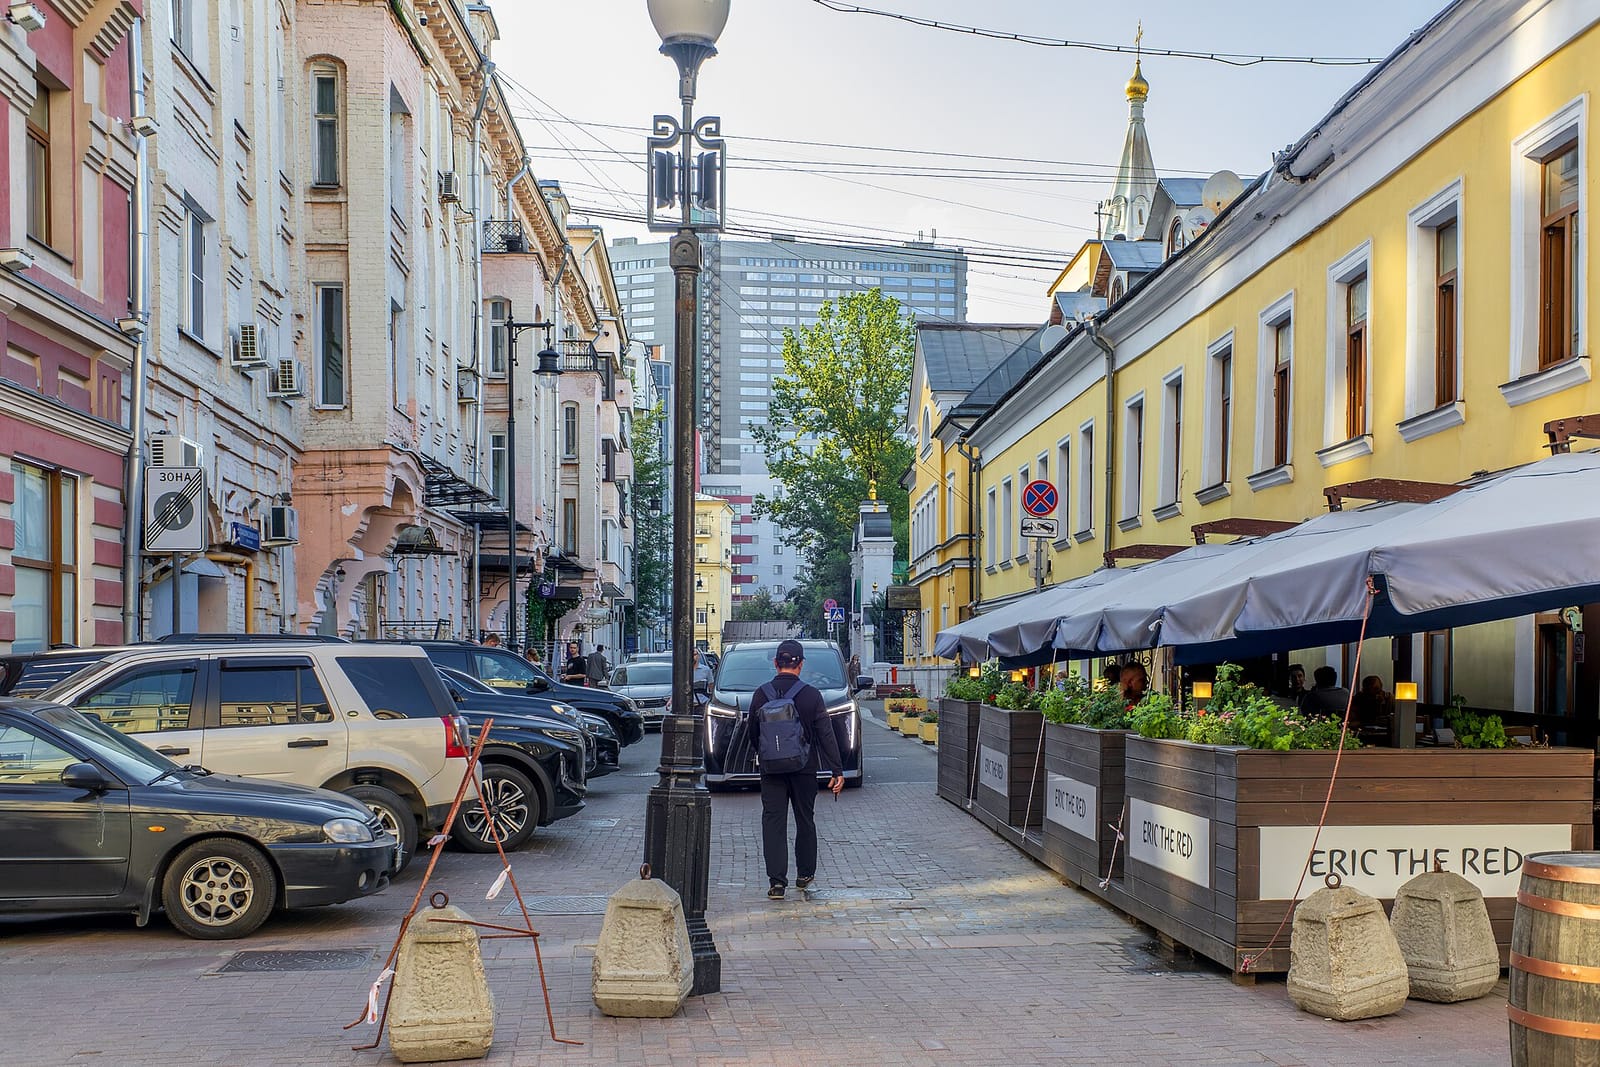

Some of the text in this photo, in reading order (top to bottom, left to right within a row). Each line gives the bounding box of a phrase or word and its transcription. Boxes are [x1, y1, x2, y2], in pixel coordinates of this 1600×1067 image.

[159, 472, 192, 482] ЗОНА
[1054, 788, 1087, 818] ERIC THE RED
[1142, 820, 1193, 860] ERIC THE RED
[1309, 846, 1523, 876] ERIC THE RED
